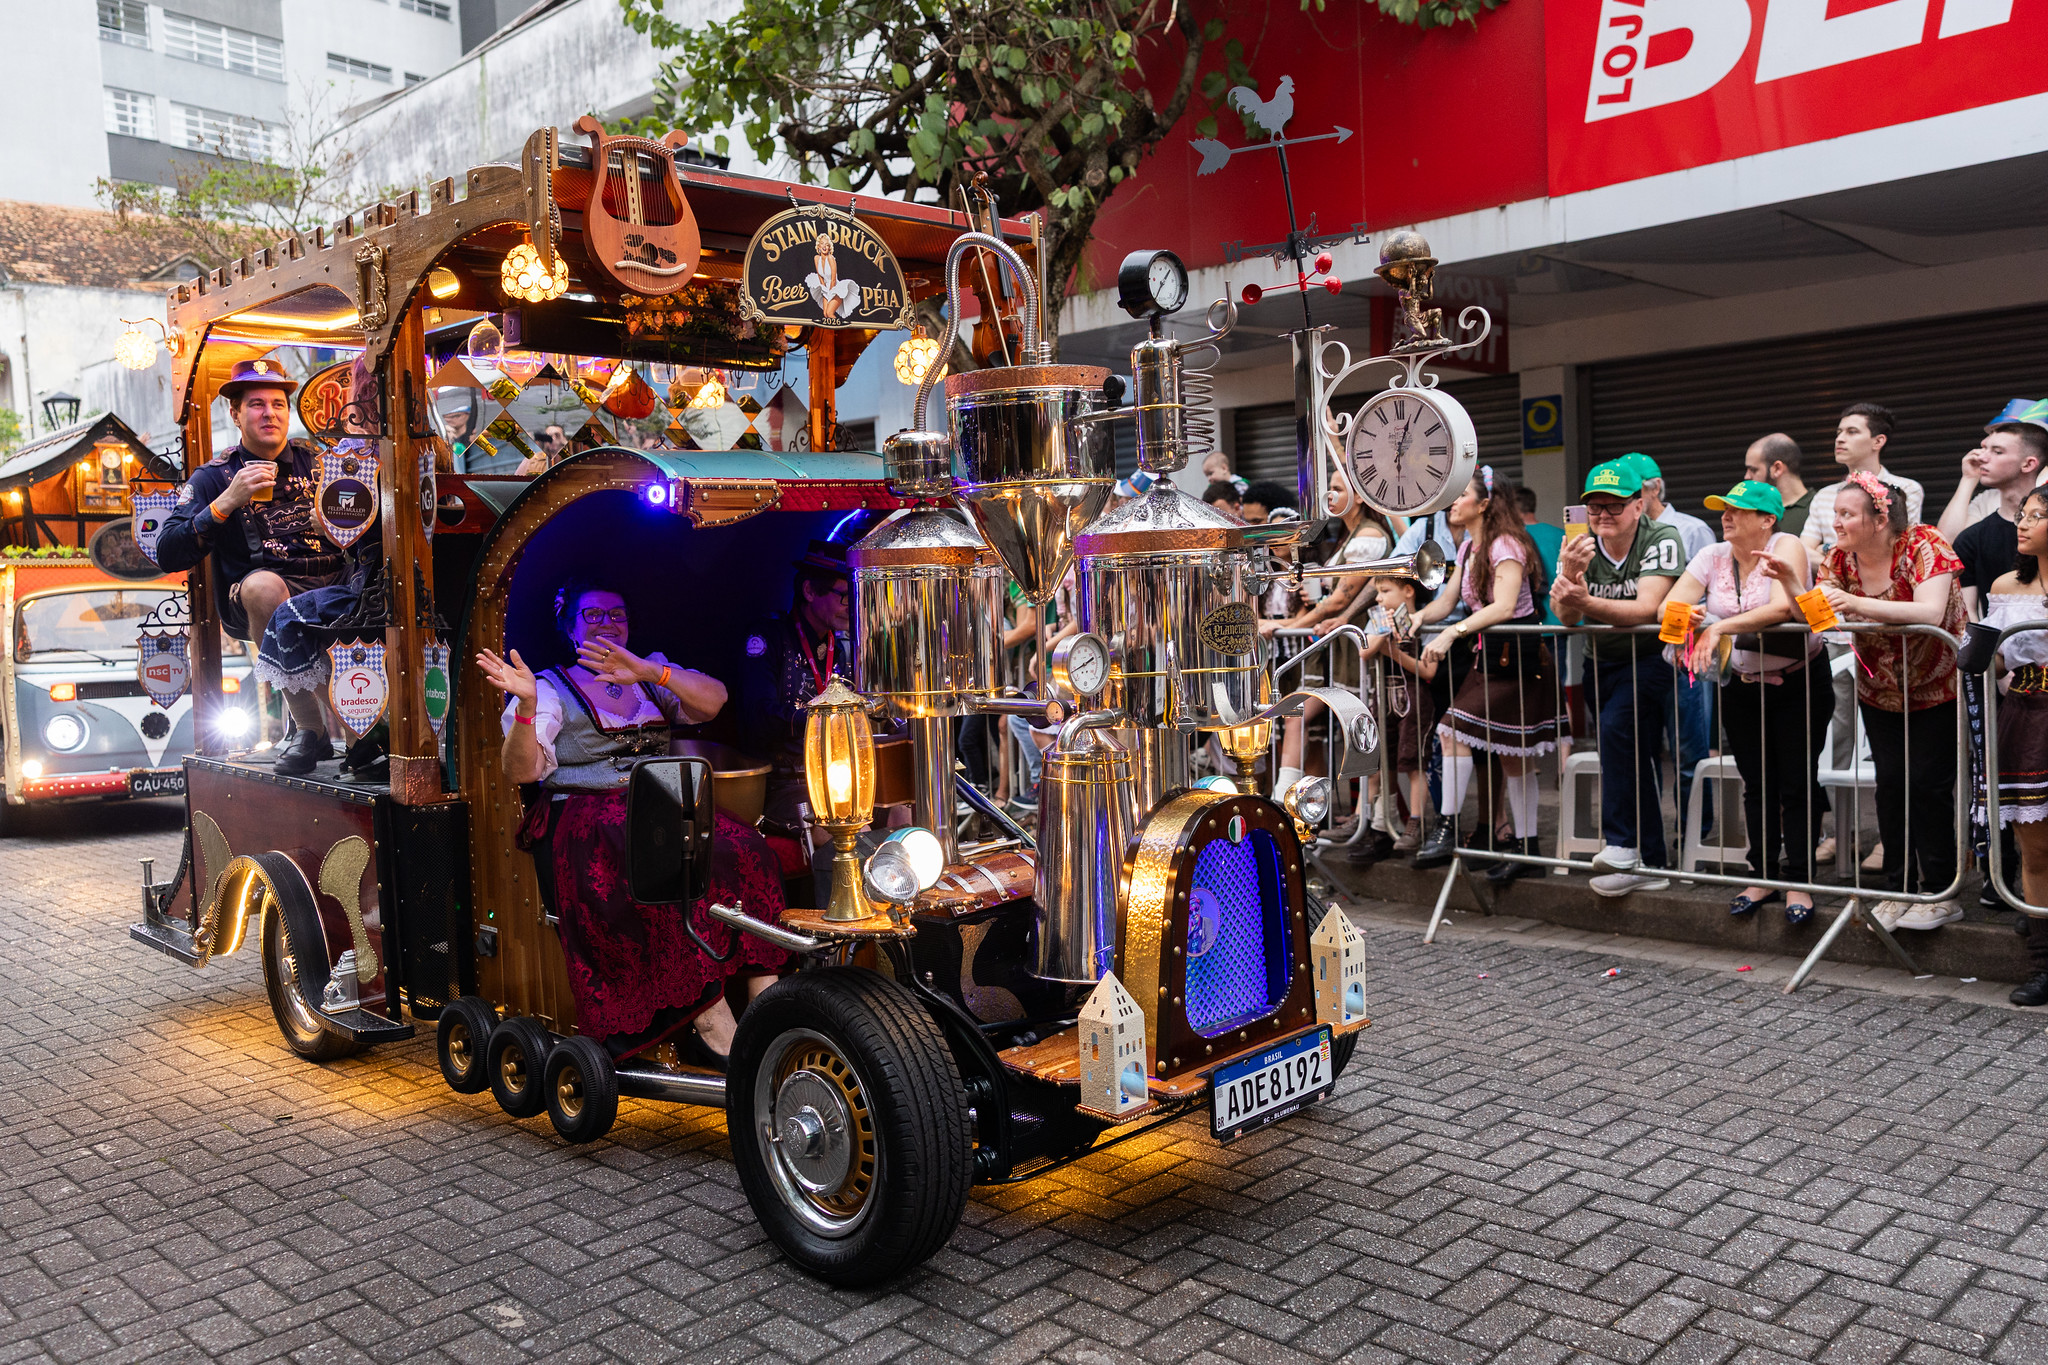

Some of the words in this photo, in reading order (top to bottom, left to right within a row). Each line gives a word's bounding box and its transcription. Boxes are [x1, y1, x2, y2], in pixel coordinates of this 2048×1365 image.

[1597, 0, 1645, 105] LOJ
[761, 220, 817, 262] STAIN
[826, 220, 889, 273] BRÜCK
[760, 275, 809, 305] Beer
[861, 283, 901, 310] PÉIA
[822, 317, 841, 326] 2026
[1640, 539, 1678, 571] 20
[149, 668, 169, 676] nsc
[172, 667, 183, 675] TV
[425, 687, 447, 700] intelbras
[341, 696, 378, 706] bradesco
[347, 707, 373, 716] seguros
[1264, 1051, 1283, 1065] BRASIL
[1263, 1116, 1270, 1124] SC
[1274, 1104, 1300, 1119] BLUMENAU
[1217, 1116, 1225, 1129] BR
